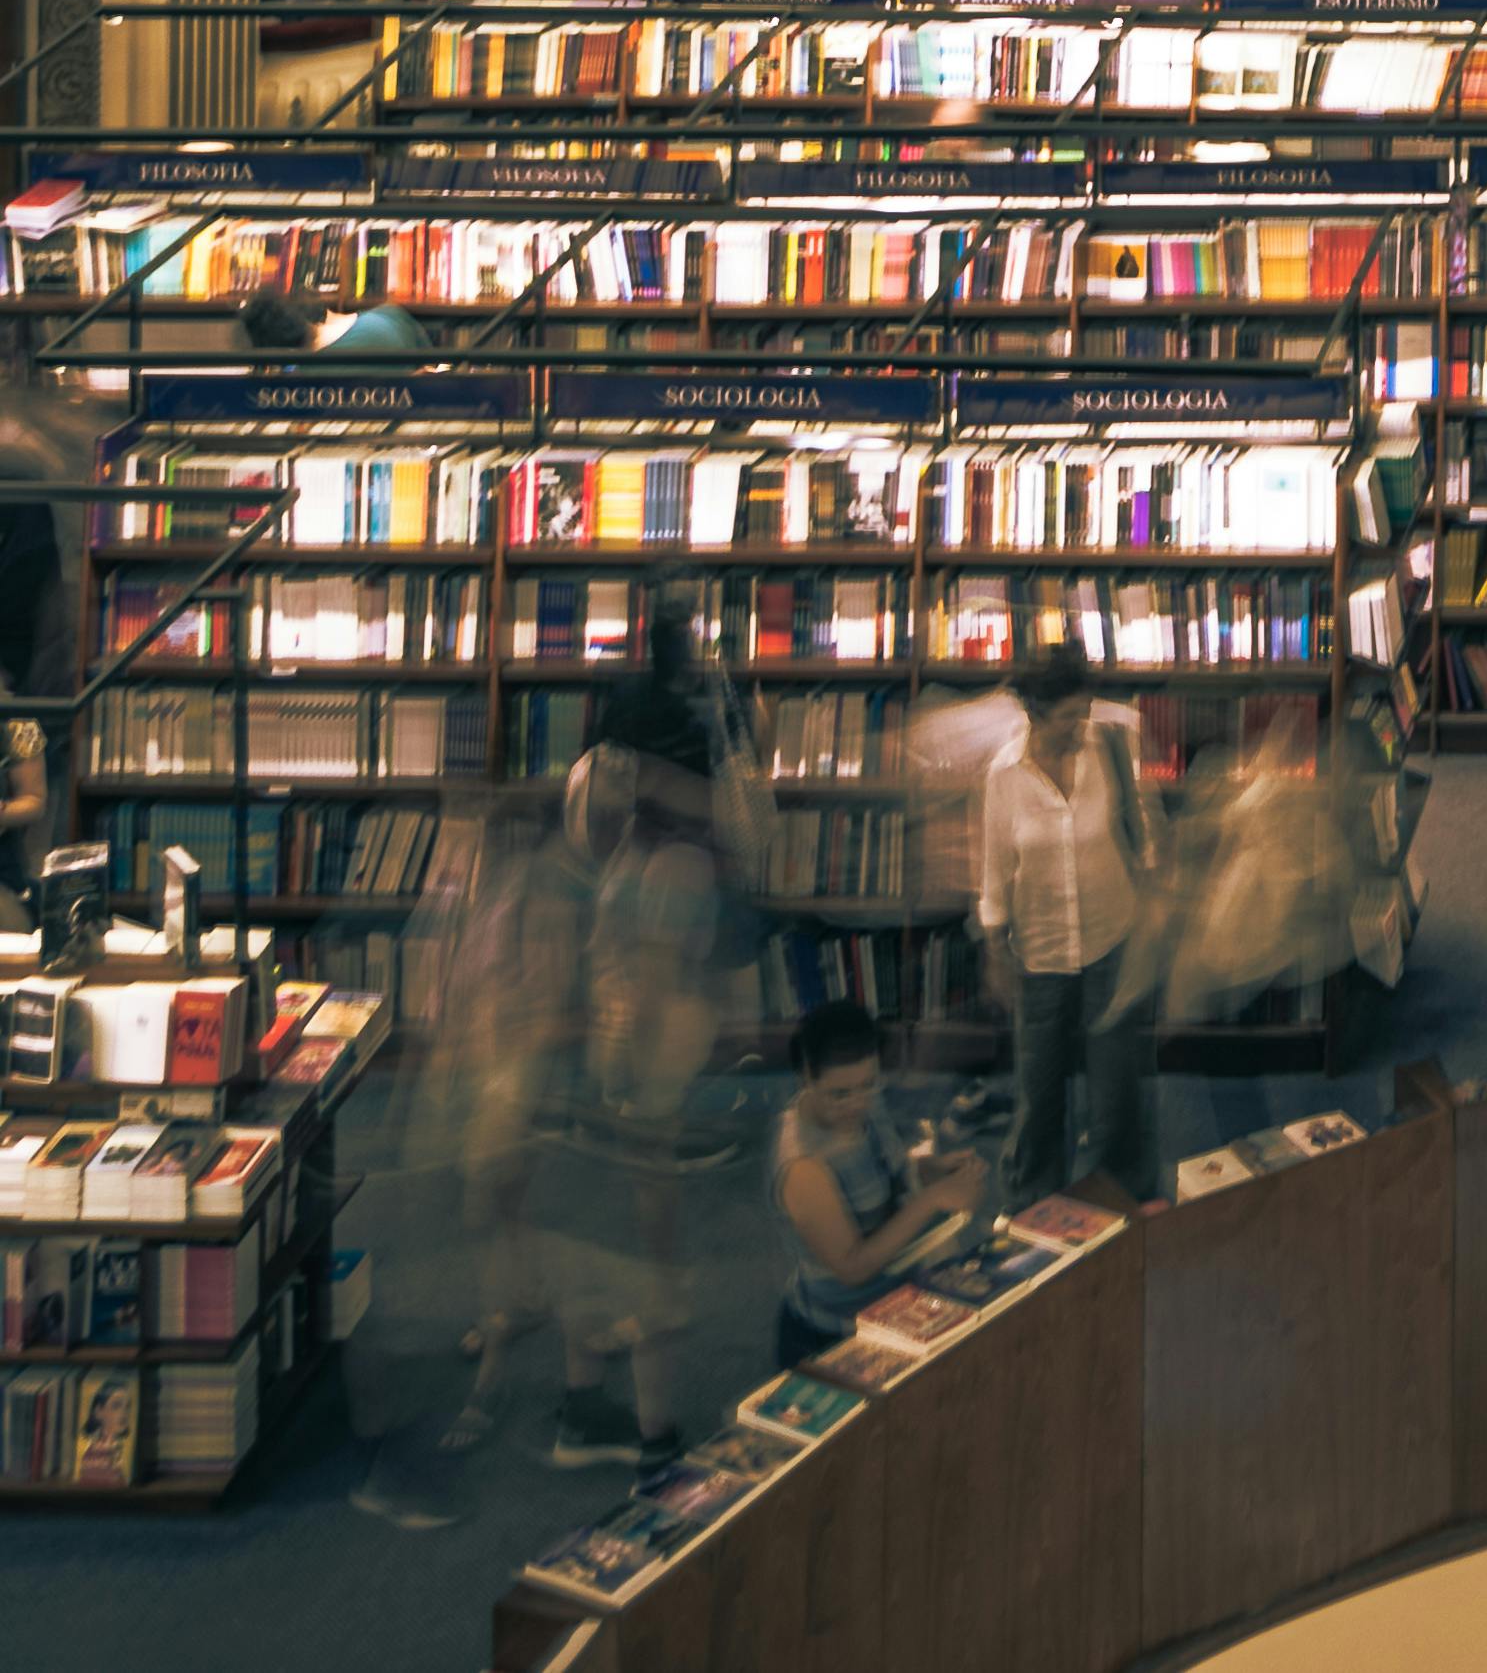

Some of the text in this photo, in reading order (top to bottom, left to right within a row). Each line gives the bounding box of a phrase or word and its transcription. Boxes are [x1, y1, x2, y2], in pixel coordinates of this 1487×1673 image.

[139, 161, 254, 182] FILOSOFIA
[491, 165, 607, 185] FILOSOFIA
[856, 169, 971, 189] FILOSOFIA
[1217, 168, 1332, 186] FILOSOFIA
[256, 386, 413, 409] SOCIOLOGIA
[664, 386, 821, 409] SOCIOLOGIA
[1072, 389, 1229, 412] SOCIOLOGIA
